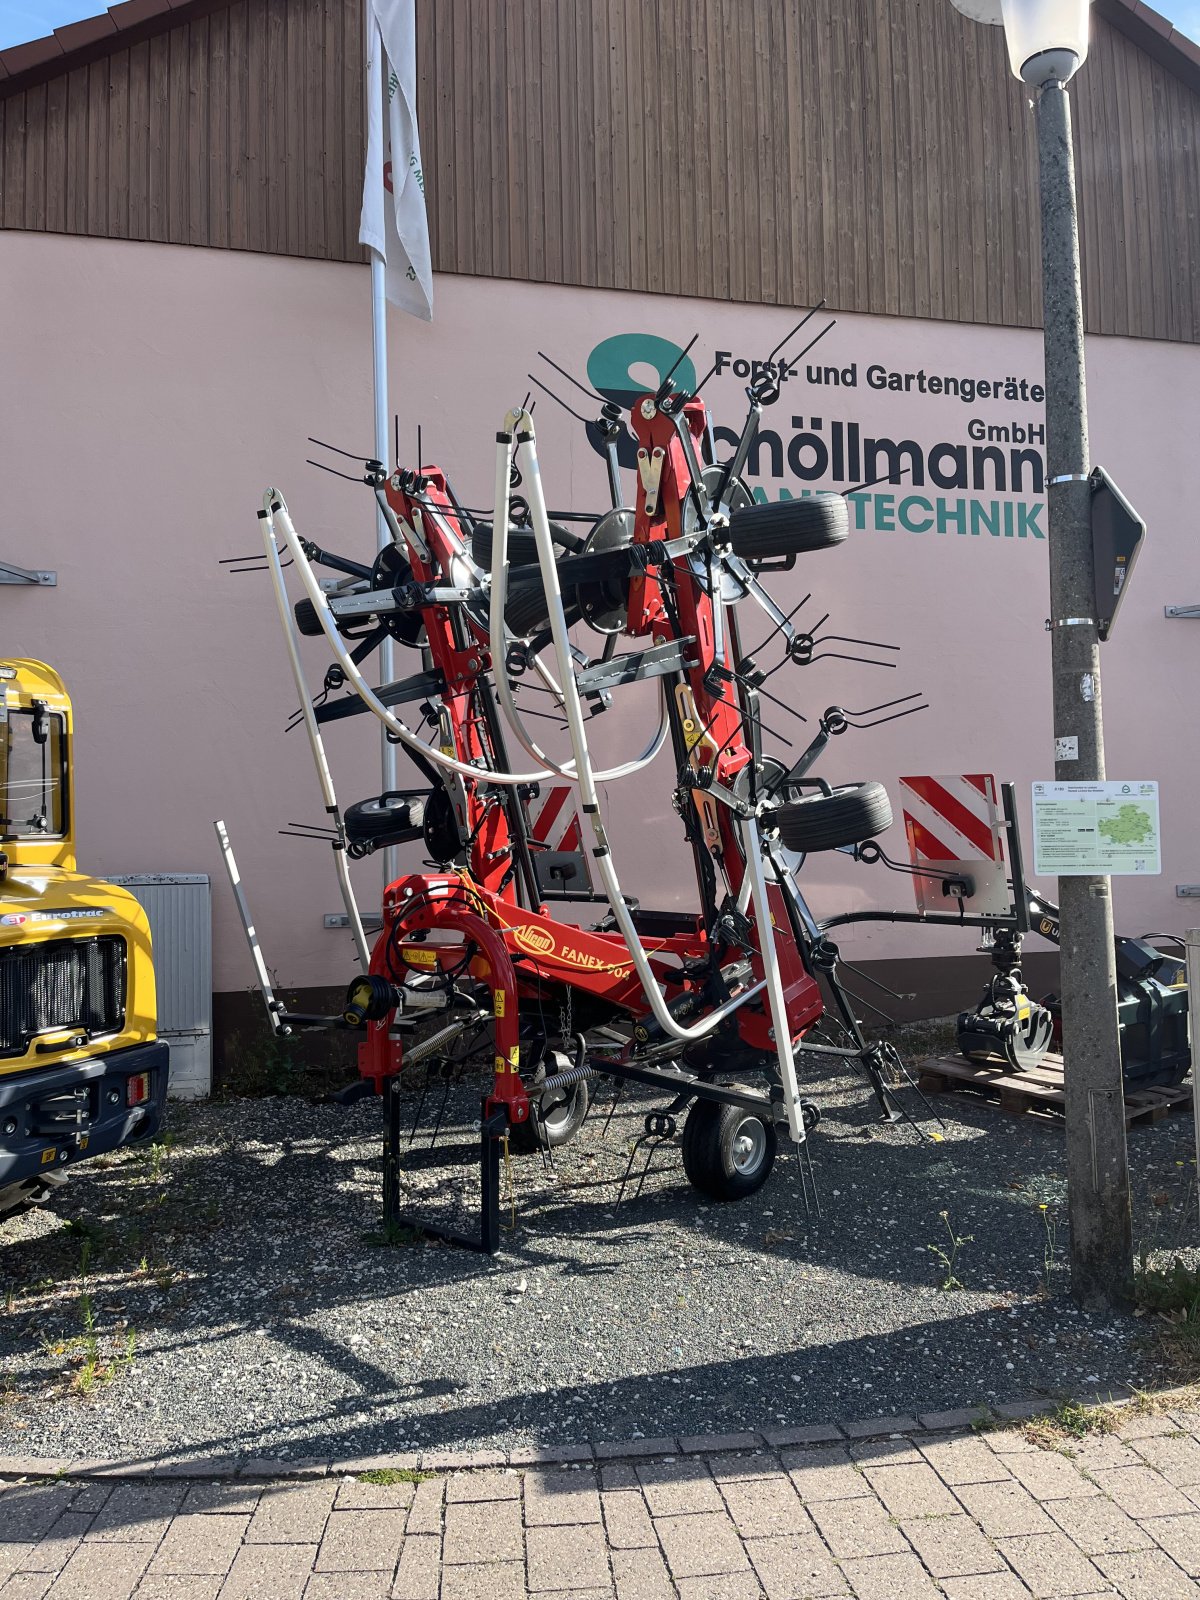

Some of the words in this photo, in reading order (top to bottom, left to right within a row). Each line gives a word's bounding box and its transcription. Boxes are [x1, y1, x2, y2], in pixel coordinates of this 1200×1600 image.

[715, 351, 798, 382] Forst-
[806, 363, 857, 387] und
[866, 364, 1045, 403] Gartengeräte
[968, 418, 1045, 445] GmbH
[31, 910, 104, 921] Eurotrac
[561, 945, 604, 971] FANEX
